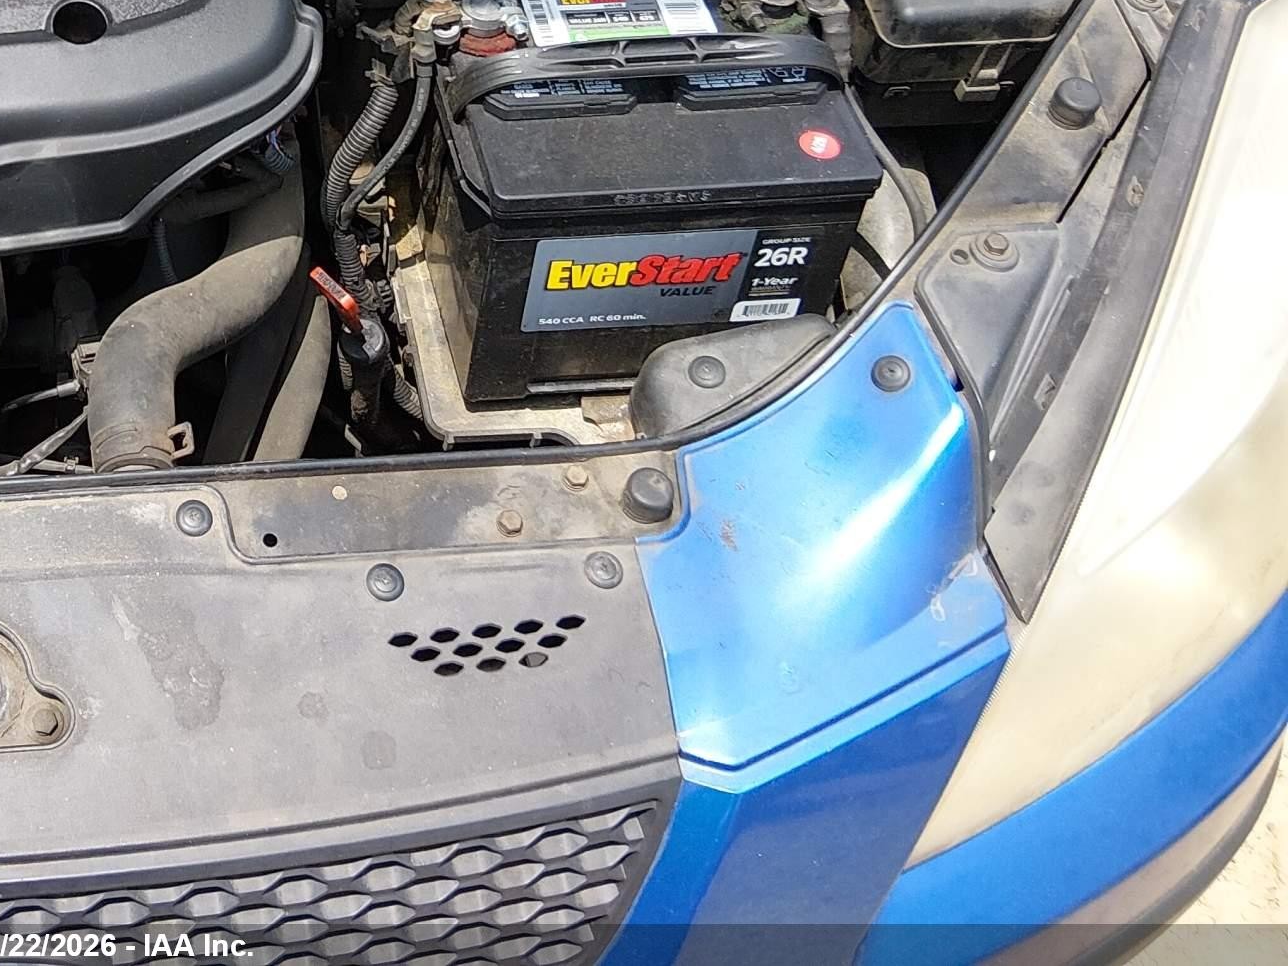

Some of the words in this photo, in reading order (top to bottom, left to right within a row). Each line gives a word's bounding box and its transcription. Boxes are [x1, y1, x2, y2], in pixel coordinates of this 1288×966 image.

[754, 246, 808, 267] 26R
[546, 251, 743, 291] EverStart
[751, 276, 799, 287] 1-Year
[659, 286, 716, 298] VALUE
[538, 316, 560, 325] 540
[562, 316, 584, 324] CCA
[589, 314, 605, 323] RC
[606, 314, 621, 322] 60
[622, 313, 646, 322] min.
